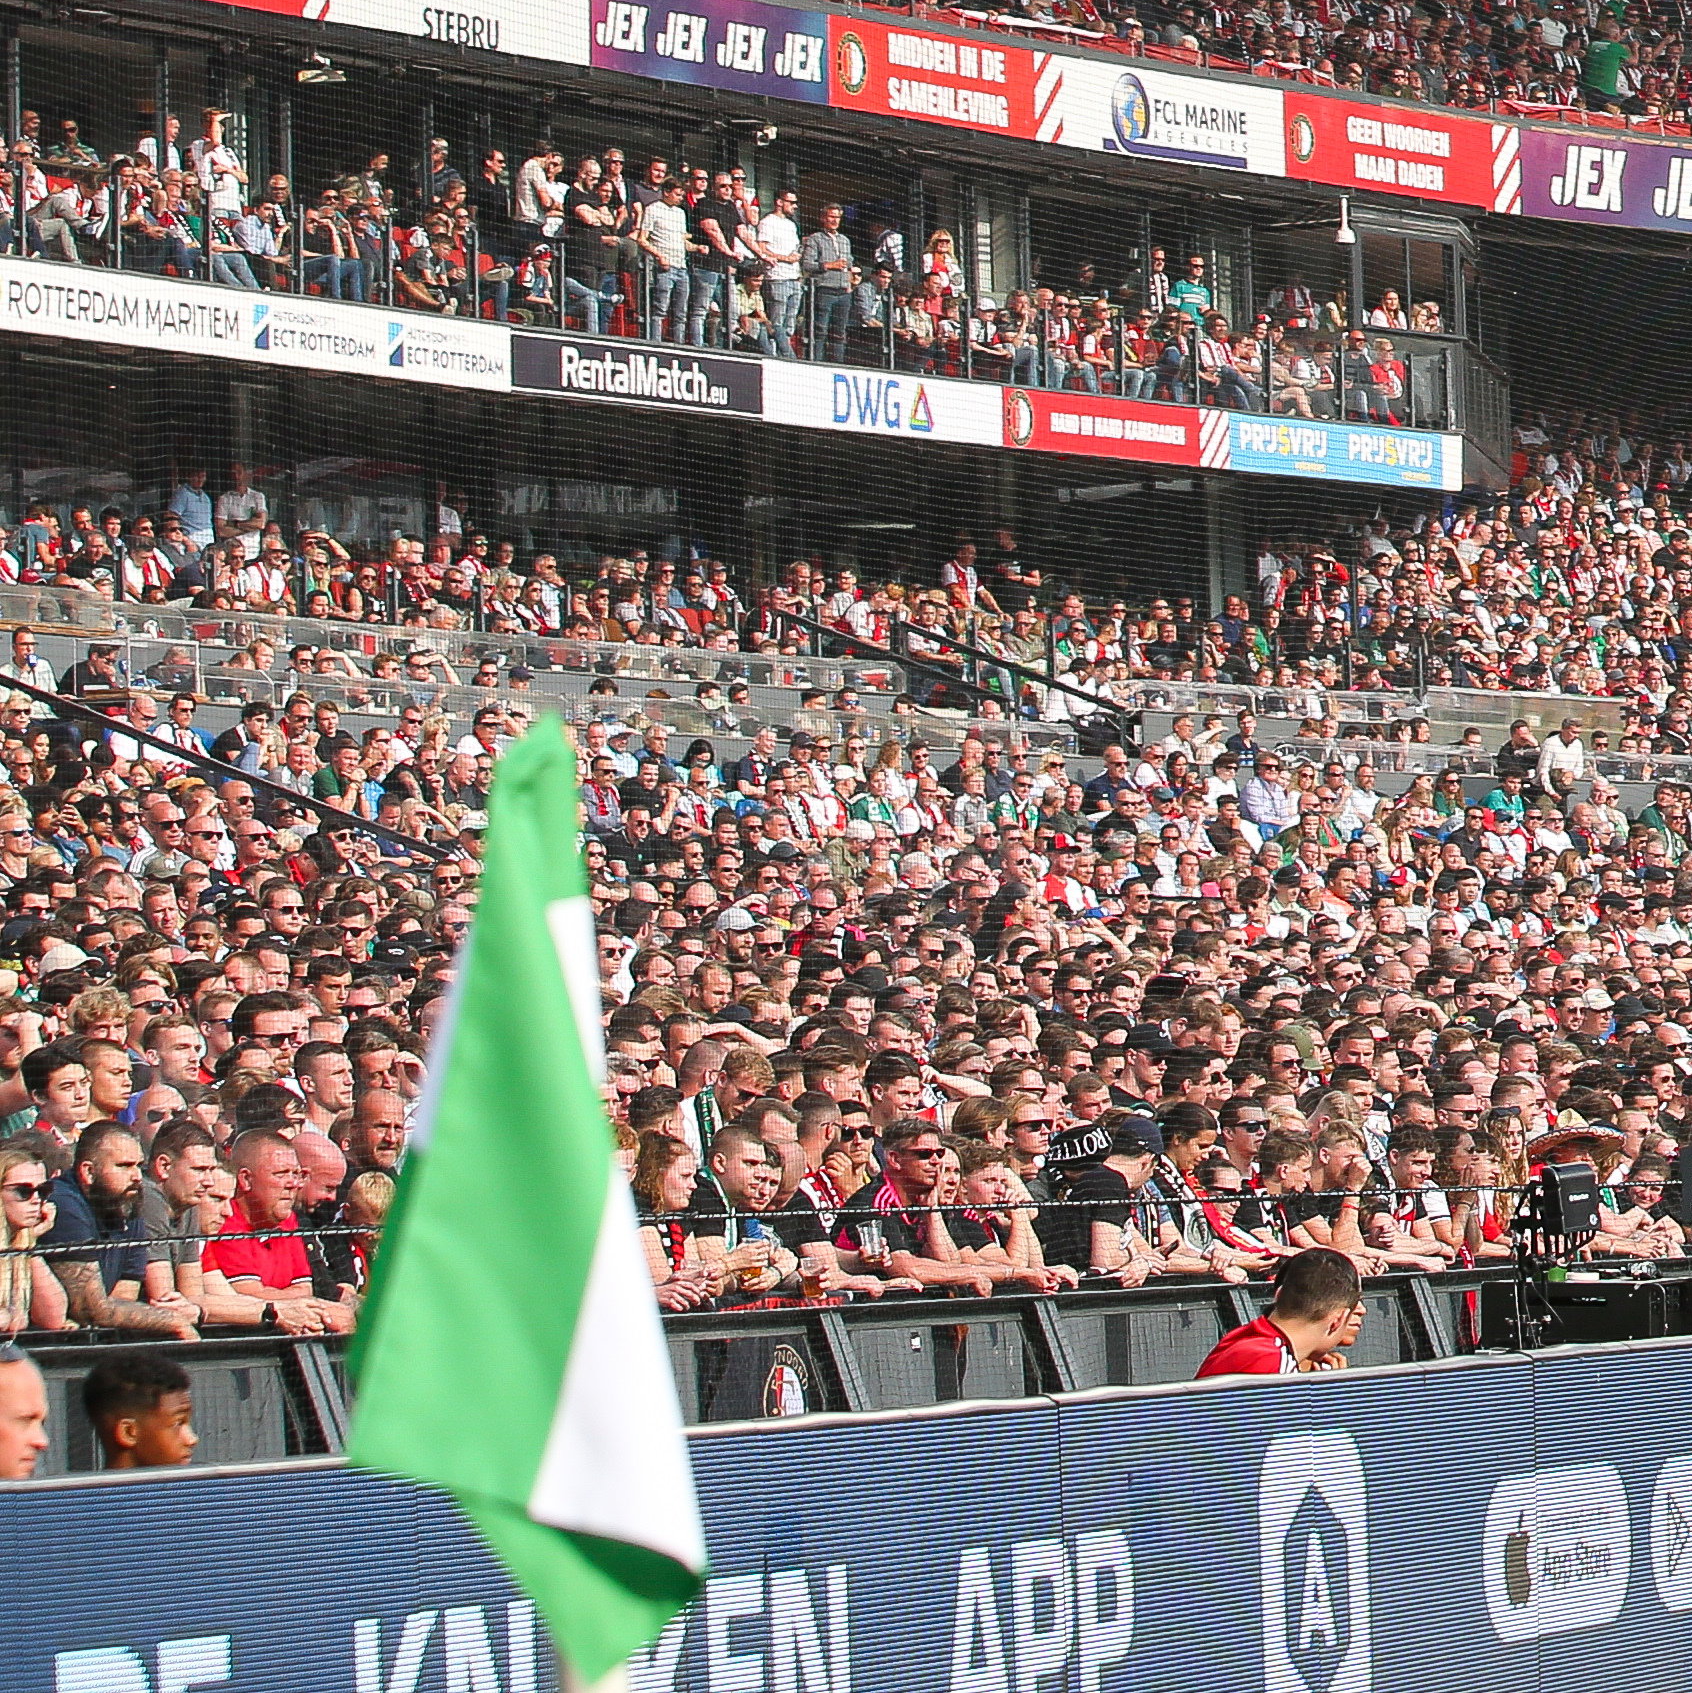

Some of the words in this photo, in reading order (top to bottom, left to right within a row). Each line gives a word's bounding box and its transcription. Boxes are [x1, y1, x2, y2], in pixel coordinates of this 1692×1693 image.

[422, 7, 500, 50] STEBRU
[596, 0, 649, 53] JEX
[656, 10, 708, 64] JEX
[716, 20, 768, 74] JEX
[774, 31, 825, 84] JEX
[887, 32, 957, 75] MIDDEN
[959, 46, 980, 78] IN
[982, 51, 1007, 84] DE
[887, 76, 1010, 129] SAMENLEVING
[1153, 98, 1182, 127] FCL
[1185, 103, 1249, 136] MARINE
[1153, 129, 1249, 154] AGENCIES
[1346, 115, 1383, 146] GEEN
[1384, 120, 1451, 159] WOORDEN
[1354, 152, 1397, 186] MAAR
[1397, 159, 1446, 193] DADEN
[1550, 144, 1630, 214] JEX
[8, 279, 140, 330] ROTTERDAM
[145, 299, 241, 342] MARITIEM
[273, 328, 297, 349] ECT
[299, 332, 376, 360] ROTTERDAM
[406, 346, 431, 368] ECT
[432, 350, 505, 376] ROTTERDAM
[559, 345, 729, 407] RentalMatch.eu
[831, 373, 902, 429] DWG
[949, 1529, 1136, 1693] APP
